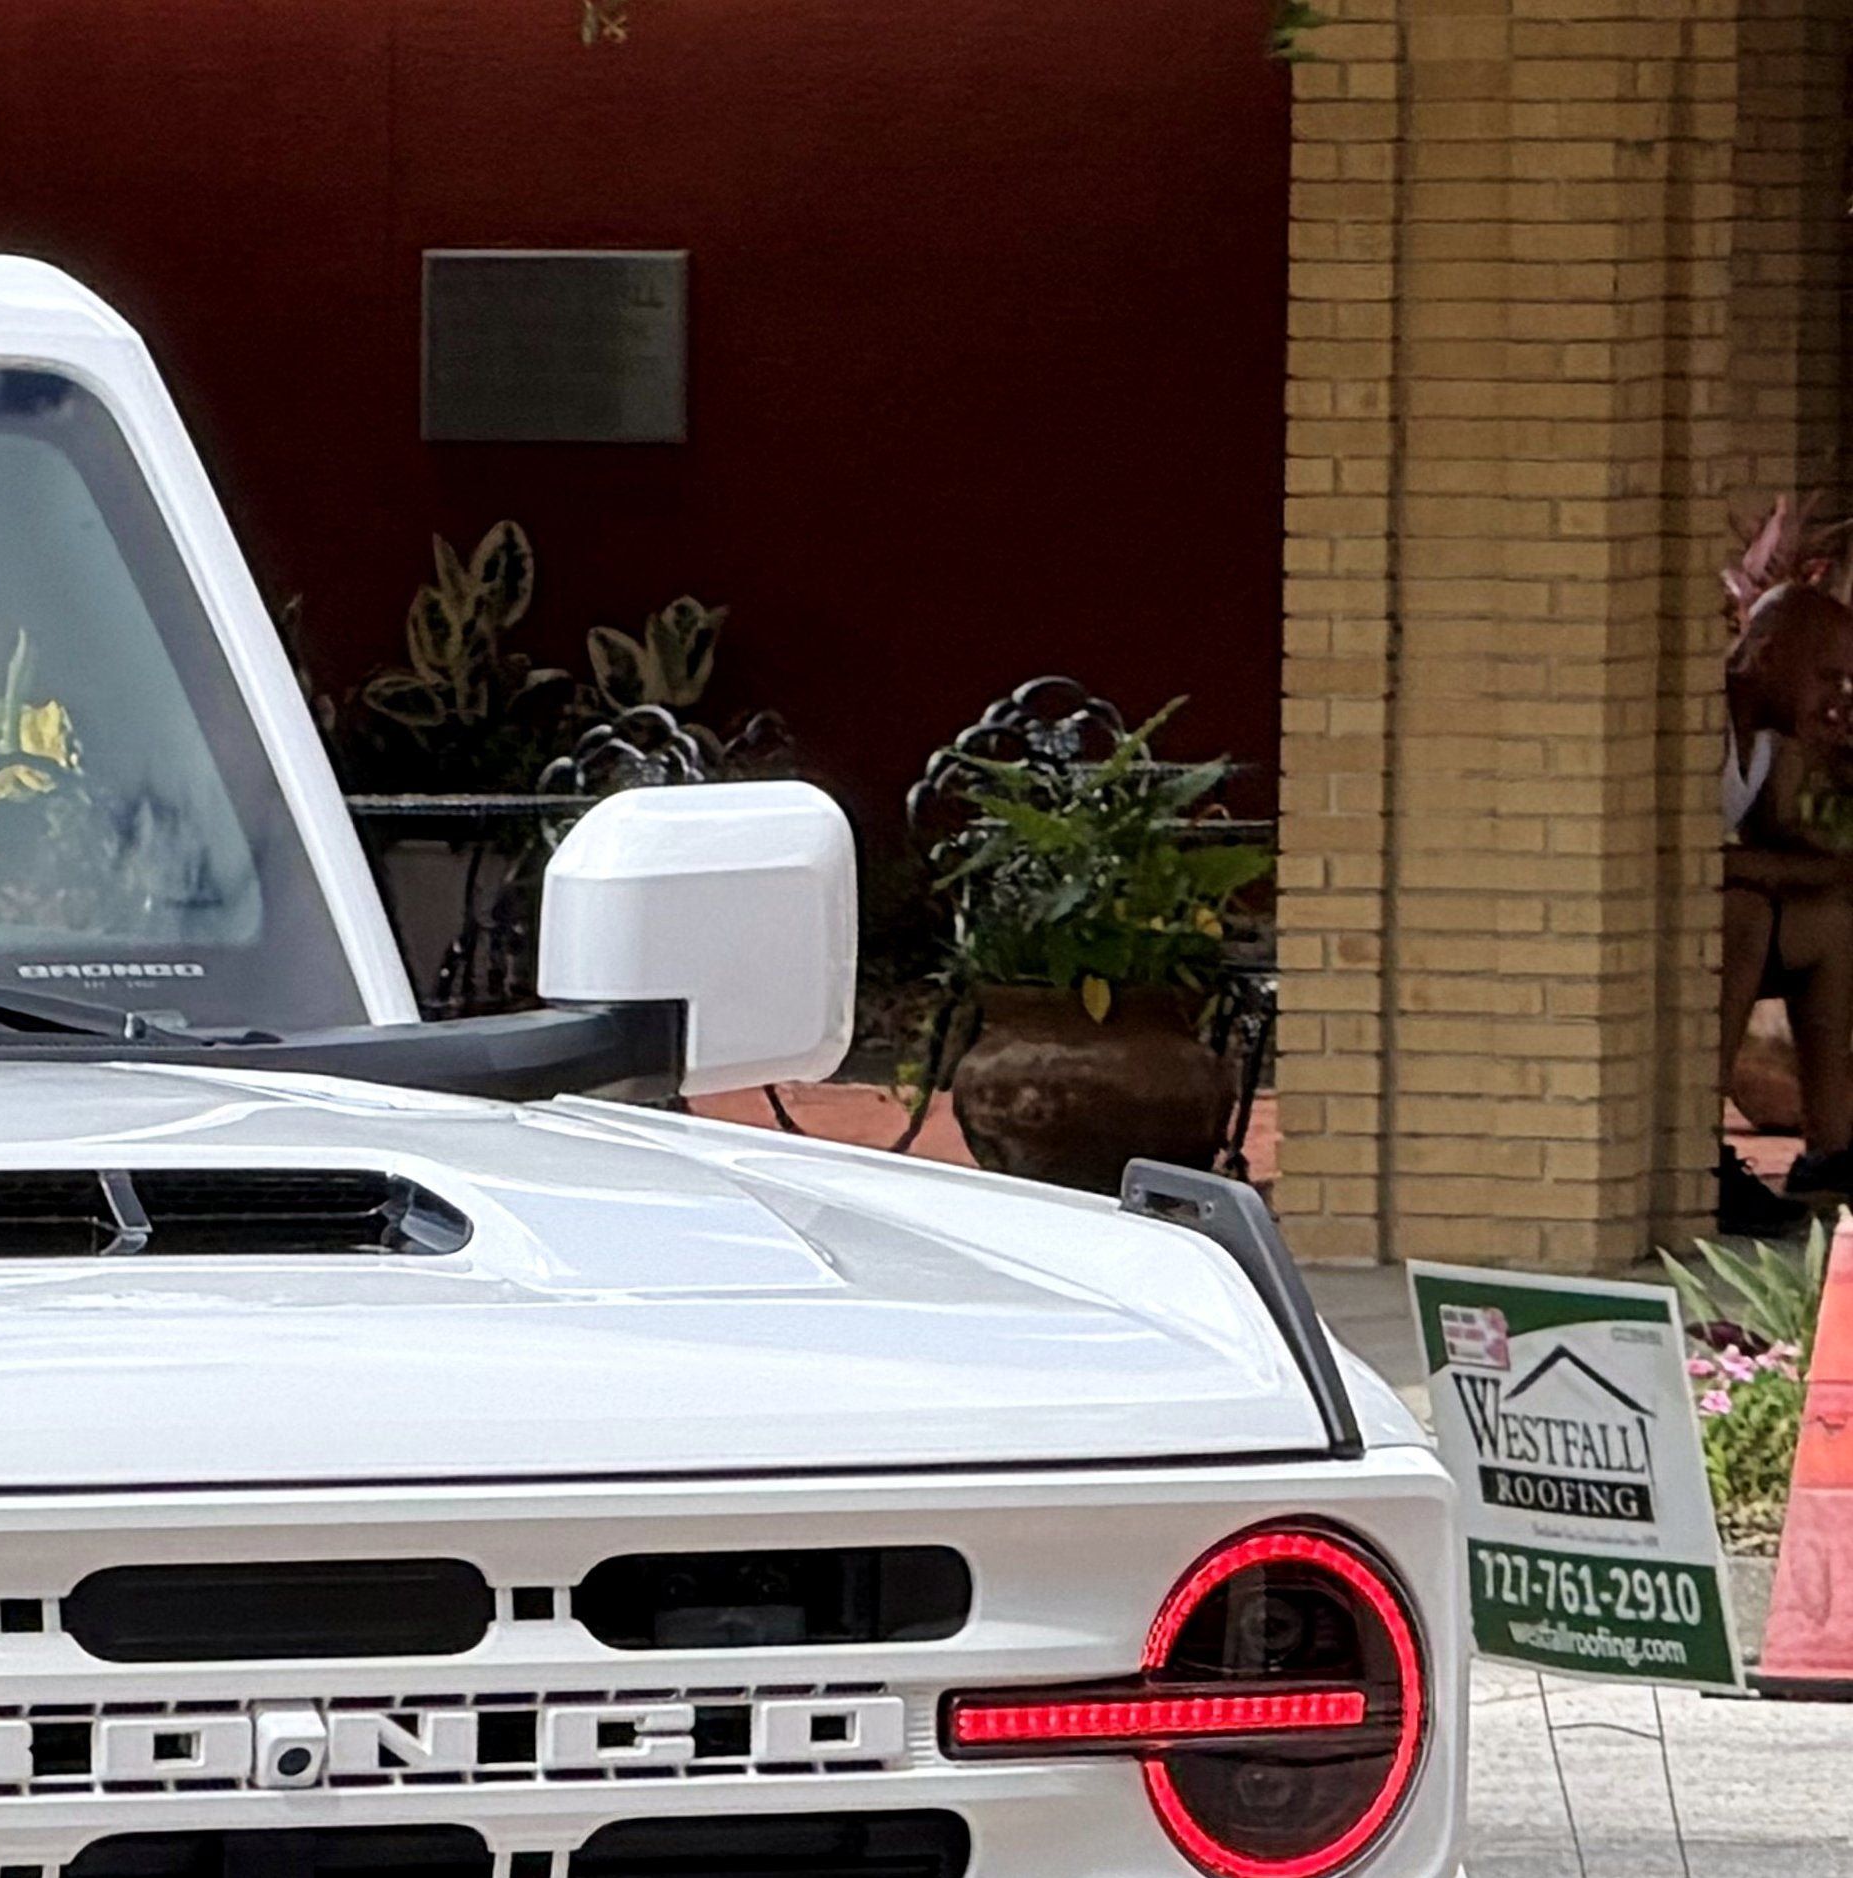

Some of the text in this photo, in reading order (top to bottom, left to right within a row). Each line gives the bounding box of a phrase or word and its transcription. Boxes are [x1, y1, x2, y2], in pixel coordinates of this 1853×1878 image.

[1451, 1373, 1646, 1473] WESTFALL
[1496, 1474, 1639, 1516] ROOFING
[1477, 1550, 1701, 1627] 727-761-2910
